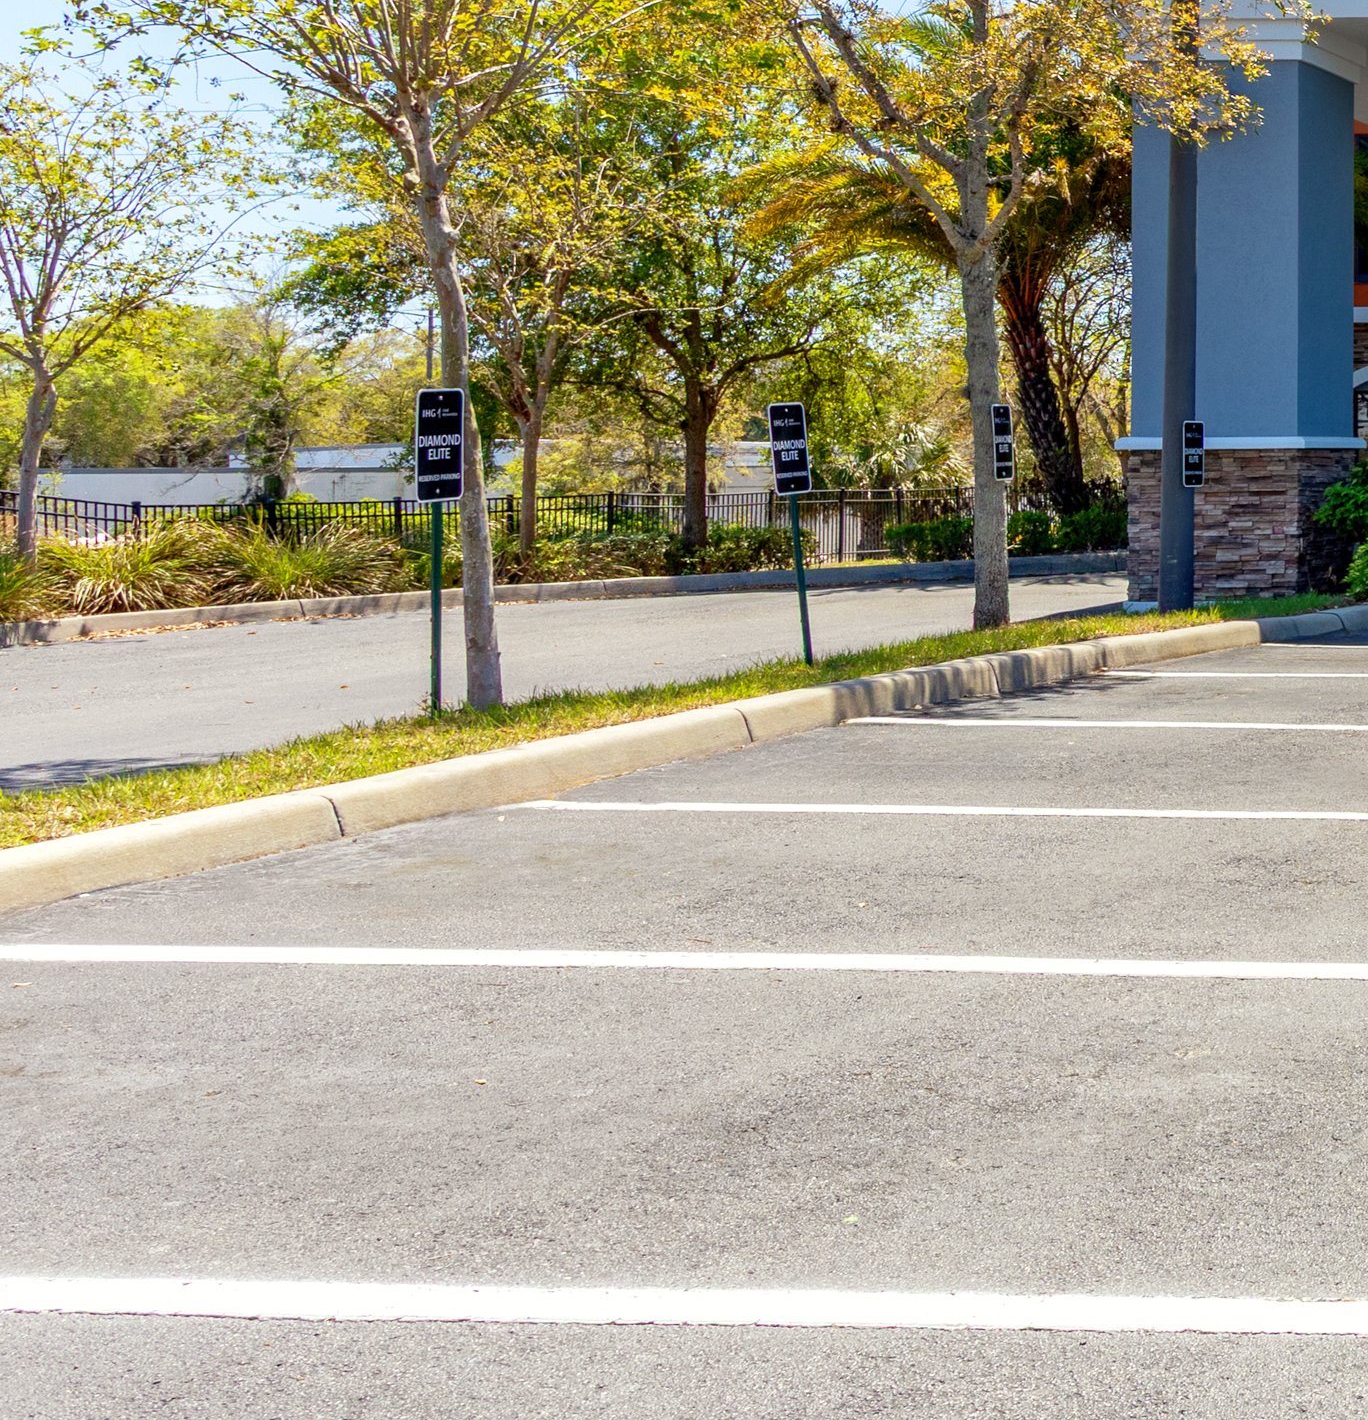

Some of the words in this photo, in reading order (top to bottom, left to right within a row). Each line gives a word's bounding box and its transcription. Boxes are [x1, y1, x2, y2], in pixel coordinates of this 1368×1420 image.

[422, 408, 436, 418] IHG
[419, 435, 460, 447] DIAMOND
[774, 440, 805, 451] DIAMOND
[428, 448, 451, 460] ELITE
[782, 450, 799, 461] ELITE
